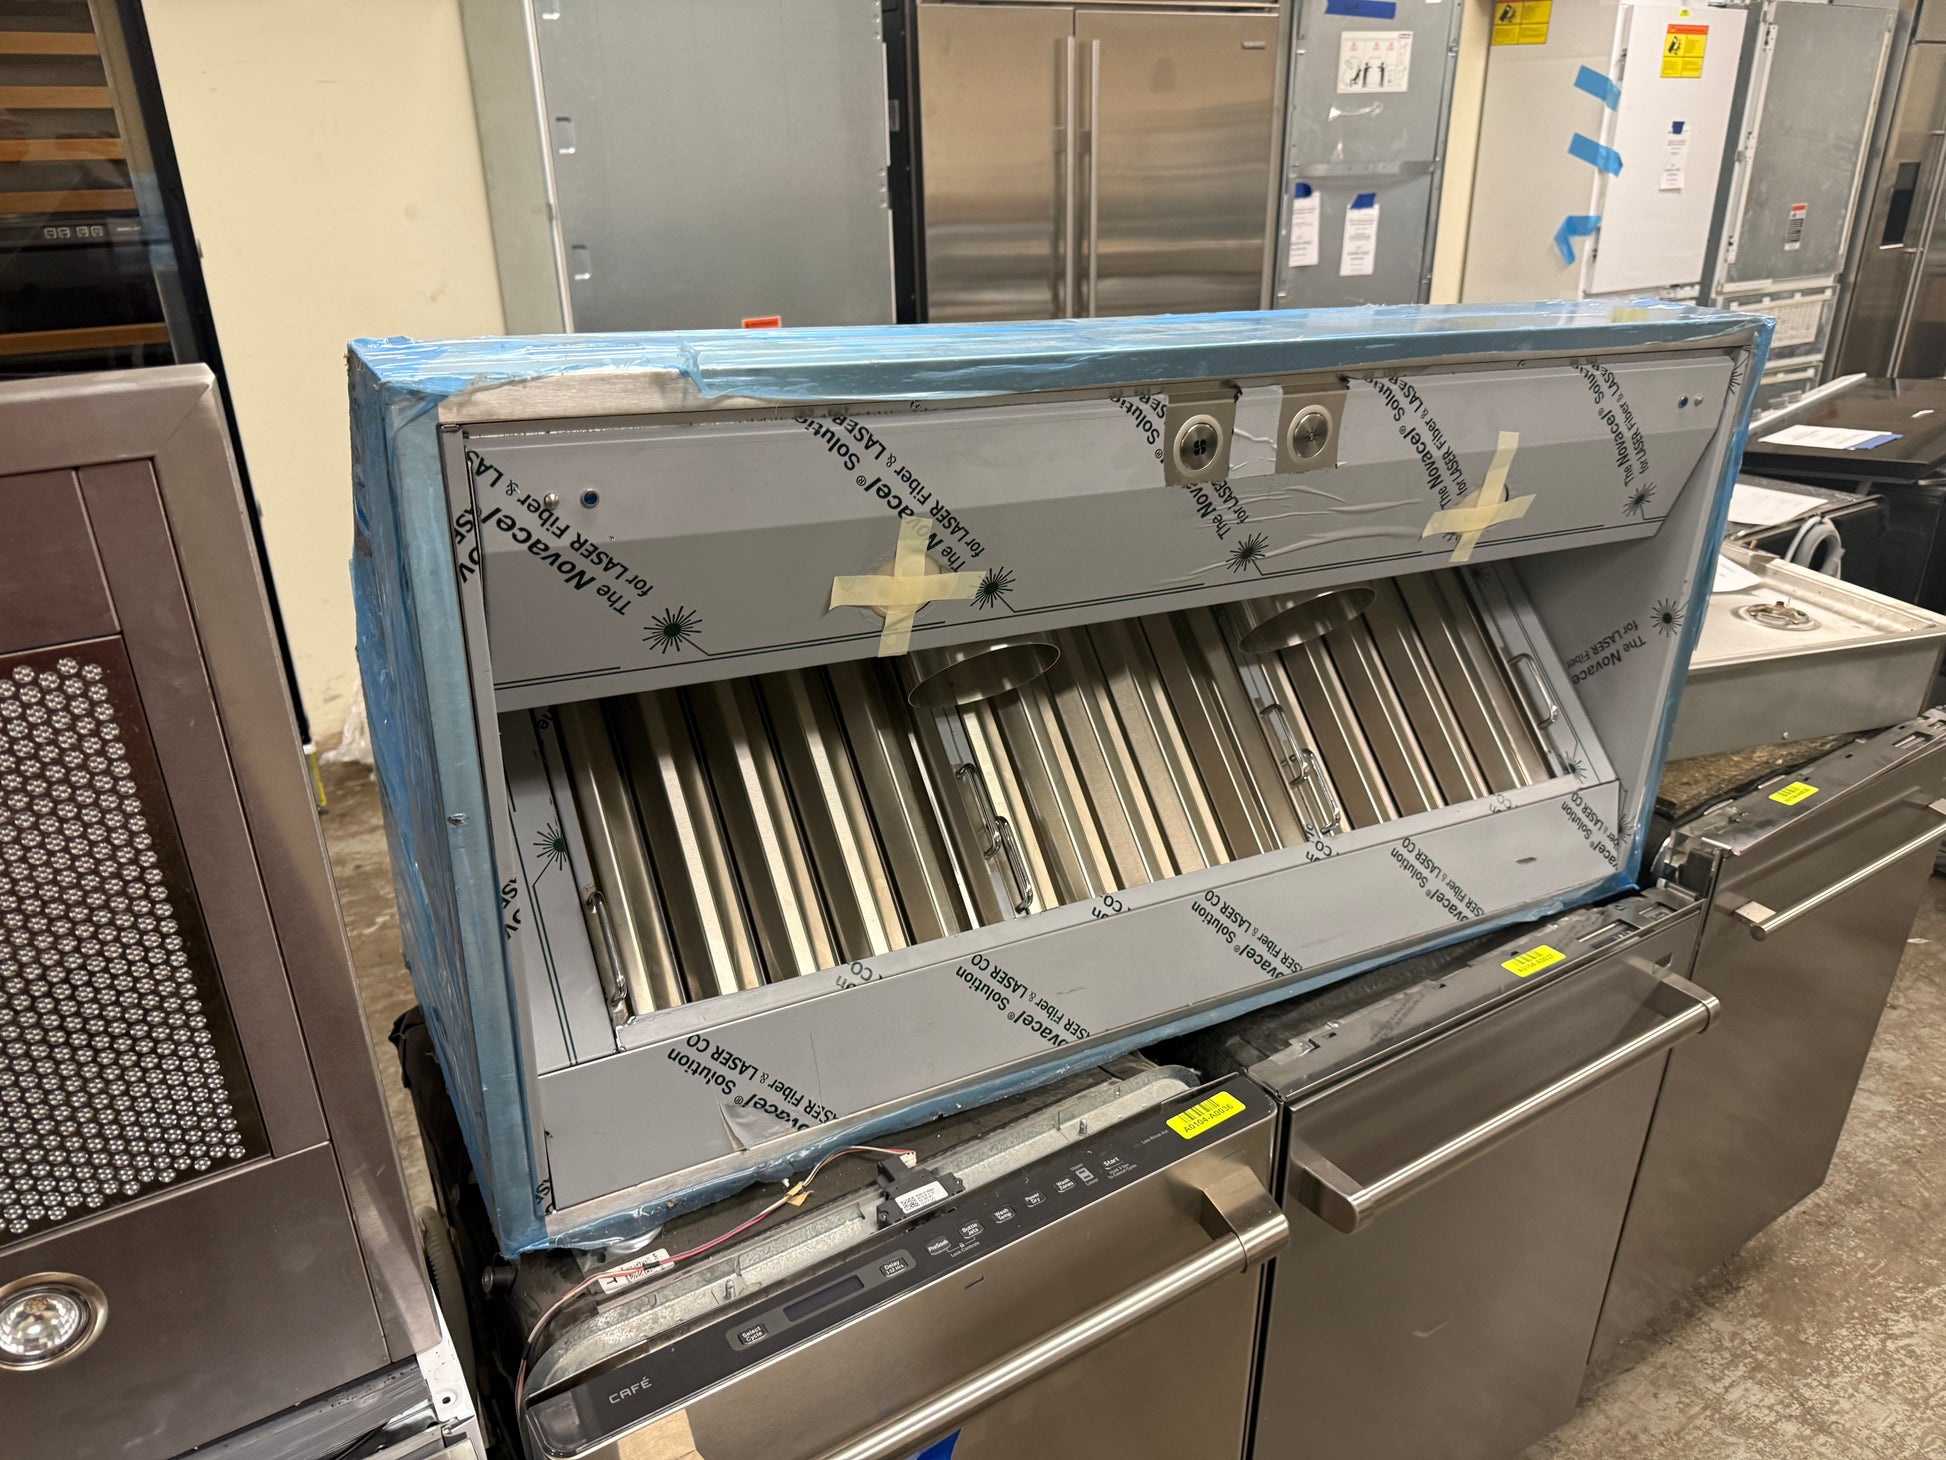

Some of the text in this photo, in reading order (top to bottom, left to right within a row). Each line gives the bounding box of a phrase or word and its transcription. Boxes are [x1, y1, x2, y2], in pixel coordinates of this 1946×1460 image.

[1620, 400, 1636, 431] Fiber
[1425, 418, 1446, 450] Fiber
[1631, 430, 1647, 461] LASER
[1442, 446, 1462, 482] LASER
[505, 480, 519, 496] &
[832, 416, 985, 558] for LASER Fiber & LASER
[1438, 486, 1451, 510] The
[1456, 479, 1468, 496] for
[517, 494, 570, 539] Fiber
[1213, 514, 1231, 540] The
[1233, 506, 1249, 524] for
[570, 533, 629, 580] LASER
[942, 546, 966, 572] The
[626, 575, 653, 597] for
[596, 584, 631, 615] The
[1623, 620, 1638, 634] for
[1590, 630, 1622, 655] LASER
[1623, 636, 1646, 652] The
[1561, 801, 1592, 839] Solution
[1582, 803, 1603, 830] LASER
[1391, 848, 1428, 888] Solution
[1415, 849, 1441, 878] LASER
[1205, 890, 1220, 906] CO
[1446, 879, 1467, 902] Fiber
[1191, 901, 1236, 943] Solution
[1220, 901, 1251, 932] LASER
[1257, 934, 1282, 958] Fiber
[971, 954, 990, 971] CO
[1280, 952, 1302, 973] SER
[956, 966, 1009, 1011] Solution
[990, 965, 1028, 998] LASER
[1029, 991, 1036, 1002] &
[1035, 998, 1064, 1024] Fiber
[686, 1034, 709, 1052] CO
[667, 1048, 736, 1094] Solution
[711, 1045, 759, 1081] LASER
[760, 1072, 769, 1083] &
[768, 1079, 804, 1107] Fiber
[1184, 1104, 1233, 1132] A0104-A0036
[1103, 1157, 1119, 1166] Start
[884, 1260, 900, 1270] Delay
[742, 1326, 761, 1338] Select
[746, 1332, 762, 1341] Cycle
[609, 1376, 652, 1404] CAFÉ
